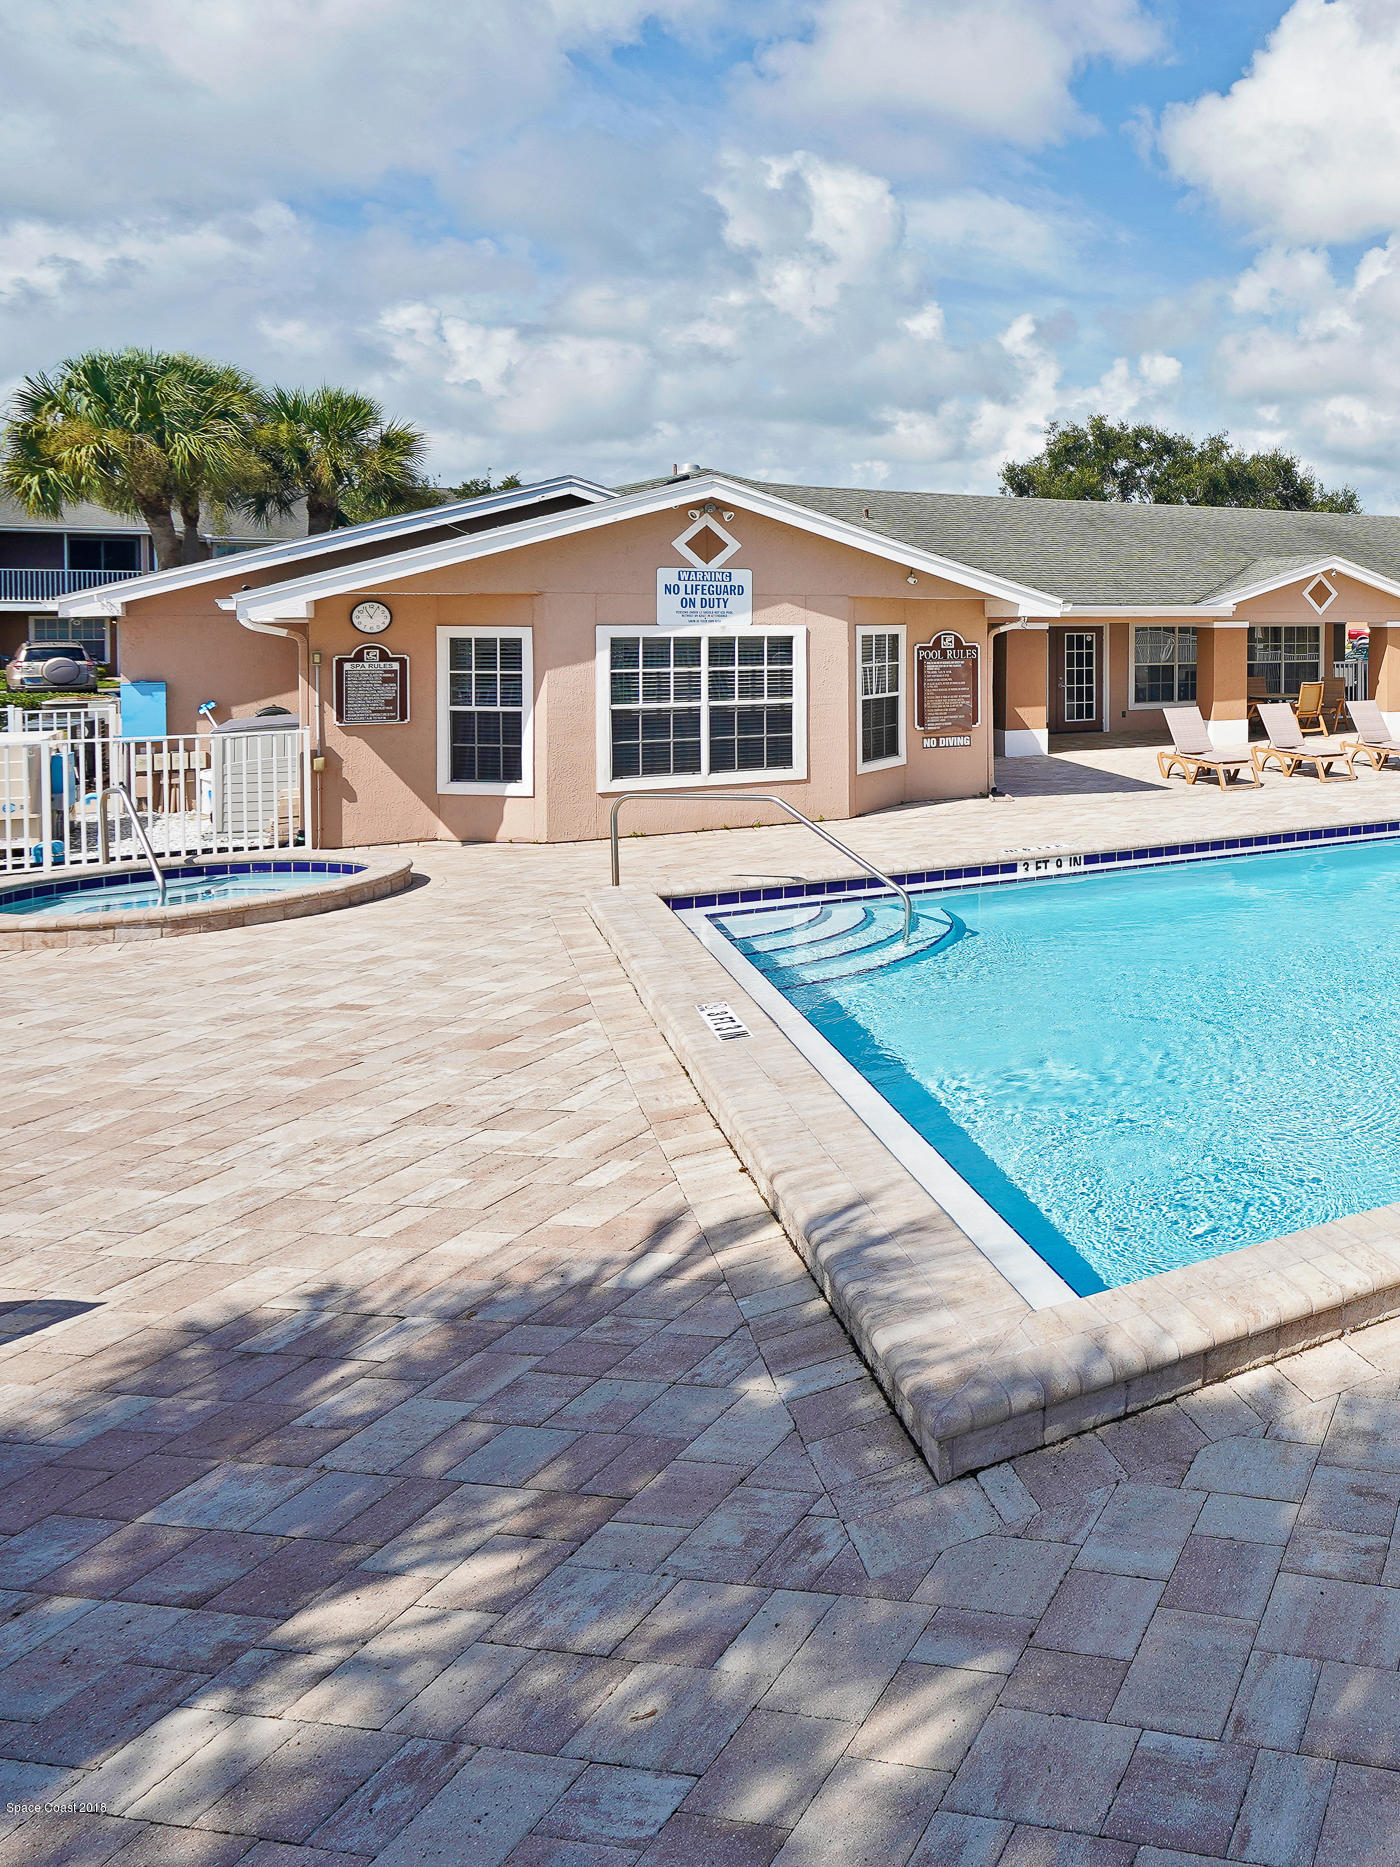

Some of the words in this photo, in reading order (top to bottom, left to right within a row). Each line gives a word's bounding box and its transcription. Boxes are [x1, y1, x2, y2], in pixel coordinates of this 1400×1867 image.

[680, 571, 730, 582] WARNING
[664, 584, 680, 595] NO
[684, 584, 744, 596] LIFEGUARD
[680, 598, 696, 608] ON
[700, 598, 729, 608] DUTY
[919, 650, 944, 660] POOL
[946, 649, 977, 659] RULES
[923, 738, 936, 748] NO
[939, 736, 970, 747] DIVING
[1023, 862, 1029, 872] 3
[1036, 860, 1050, 871] FT
[1069, 856, 1082, 867] IN
